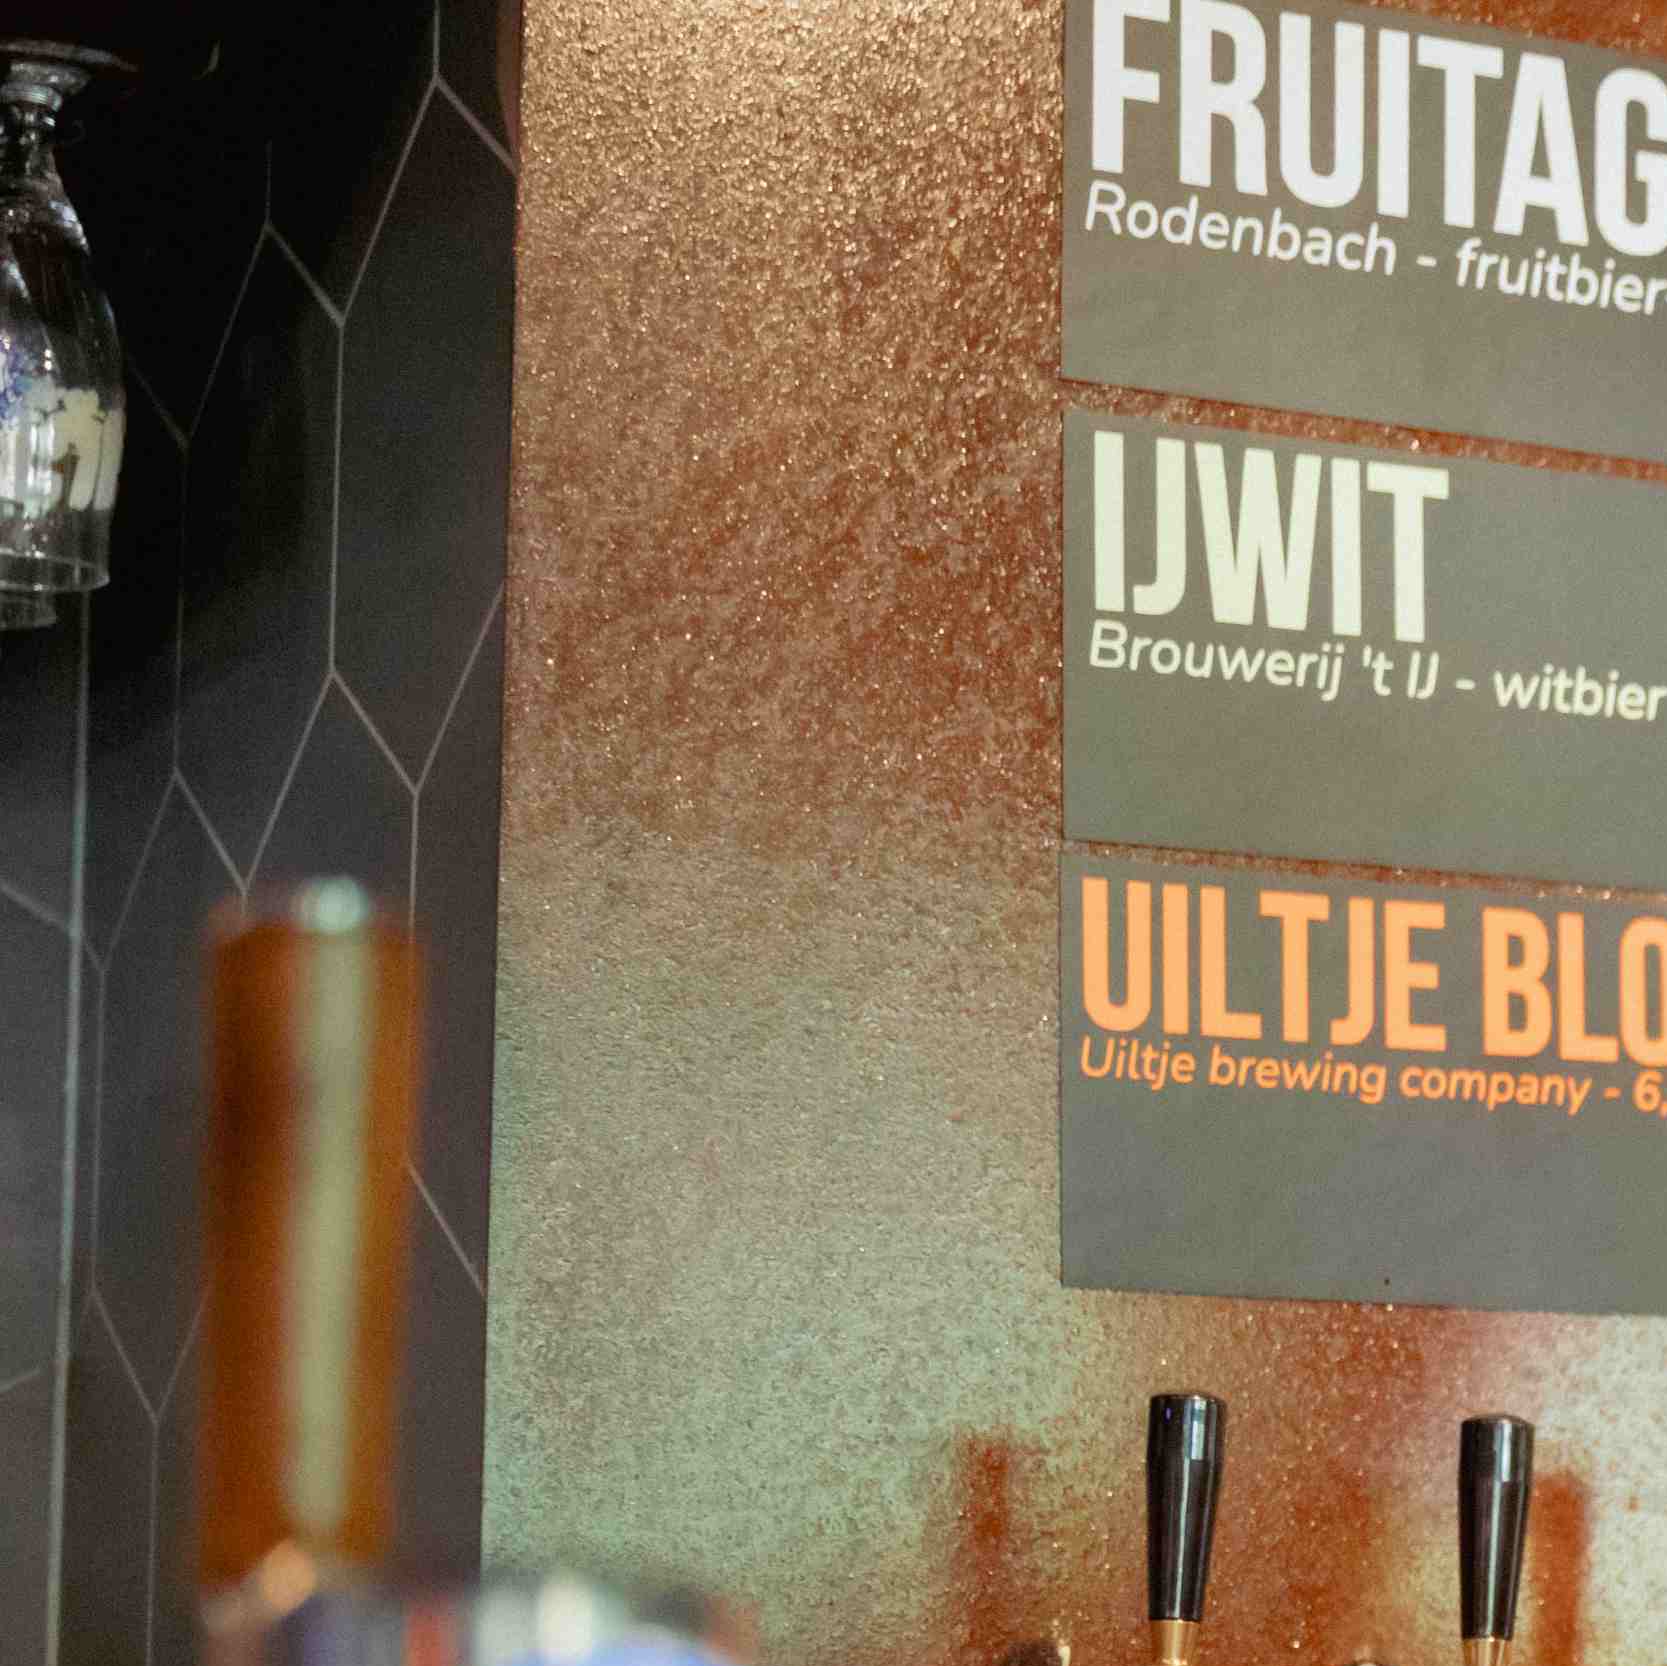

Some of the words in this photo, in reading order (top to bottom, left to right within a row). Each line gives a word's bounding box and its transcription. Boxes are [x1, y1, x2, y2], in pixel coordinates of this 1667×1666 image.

[1085, 179, 1397, 276] Rodenbach
[1093, 431, 1450, 642] IJWIT
[1089, 618, 1344, 702] Brouwerij
[1362, 645, 1394, 696] 't
[1406, 650, 1440, 699] IJ
[1081, 876, 1447, 1053] UILTJE
[1080, 1035, 1196, 1092] Uiltje
[1208, 1044, 1387, 1104] brewing
[1399, 1065, 1592, 1116] company
